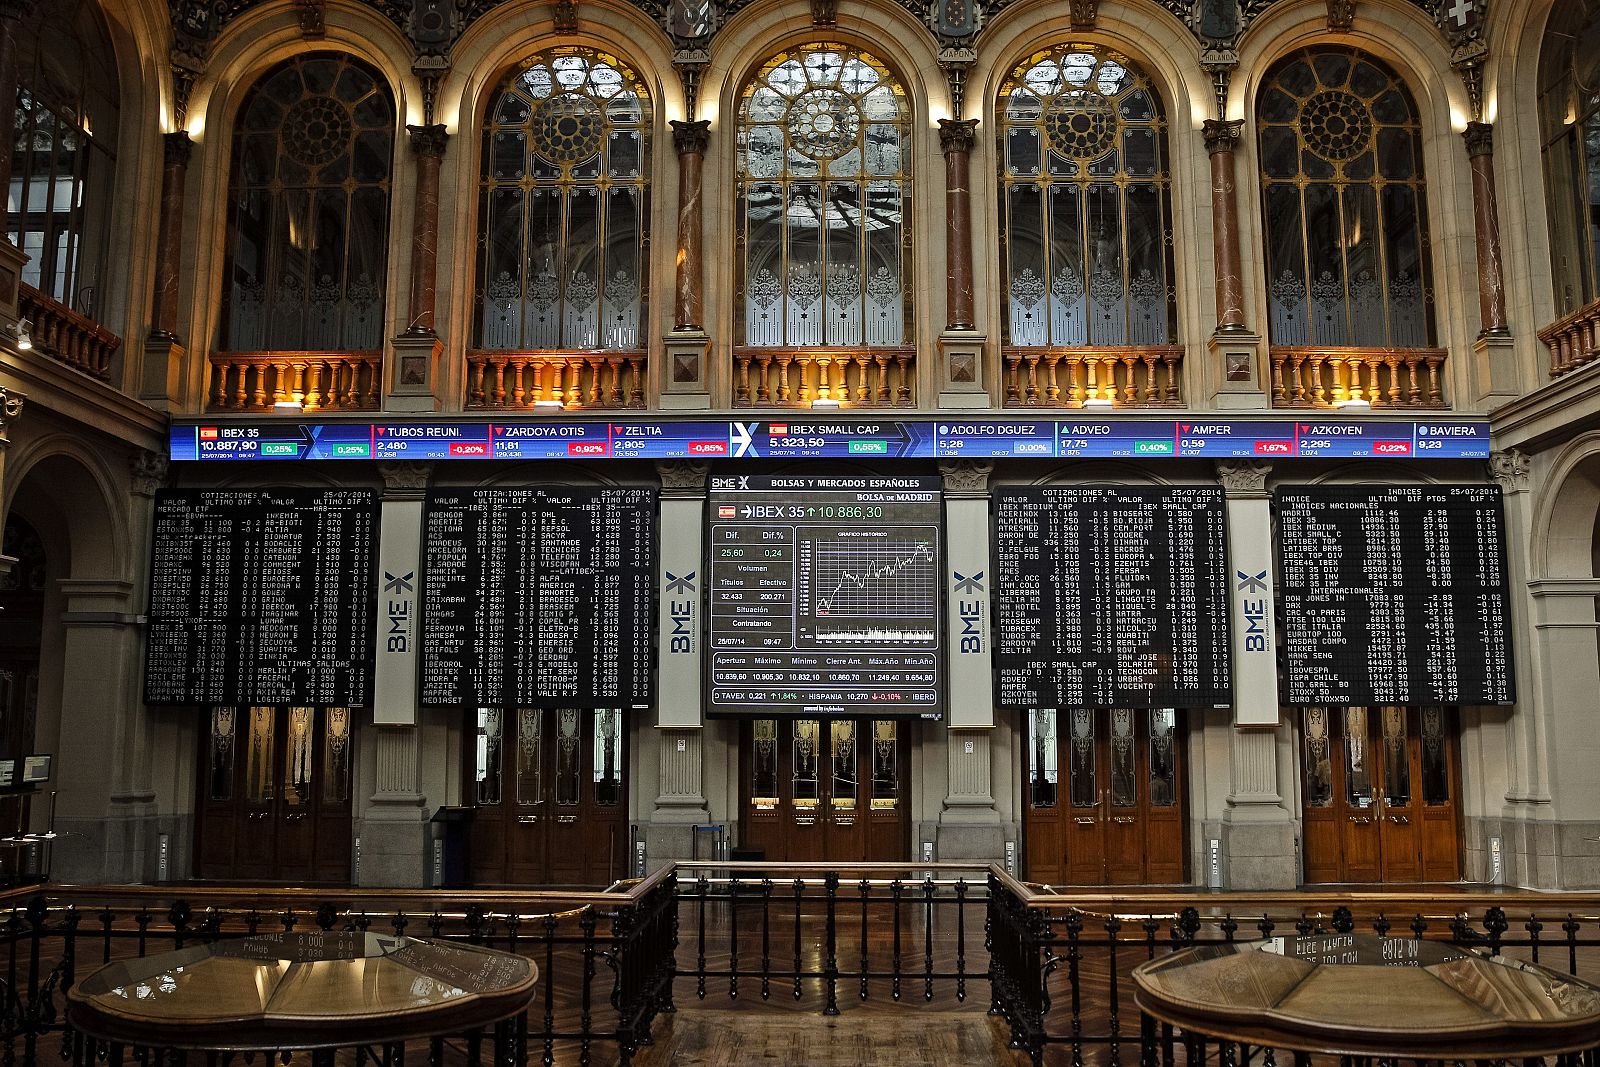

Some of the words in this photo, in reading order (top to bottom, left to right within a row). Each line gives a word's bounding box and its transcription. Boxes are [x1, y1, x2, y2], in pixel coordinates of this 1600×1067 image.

[679, 52, 705, 60] SUECIA
[944, 50, 971, 58] JAPON
[1205, 53, 1234, 61] HOLANDA
[1457, 46, 1480, 59] SUIZA
[221, 429, 245, 438] IBEX
[247, 429, 259, 438] 35
[388, 428, 424, 437] TUBOS
[426, 428, 462, 437] REUNI.
[506, 428, 557, 437] ZARDOYA
[560, 428, 585, 436] OTIS
[625, 427, 662, 436] ZELTIA
[790, 425, 816, 434] IBEX
[818, 425, 855, 434] SMALL
[857, 425, 880, 434] CAP
[950, 426, 995, 435] ADOLFO
[997, 426, 1036, 435] DGUEZ
[1071, 426, 1110, 435] ADVEO
[1192, 425, 1231, 434] AMPER
[1311, 426, 1363, 435] AZKOYEN
[1430, 426, 1476, 436] BAVIERA
[200, 441, 258, 451] 10.887,90
[377, 442, 407, 451] 2,480
[495, 441, 519, 450] 11,81
[614, 441, 645, 449] 2,905
[769, 438, 825, 448] 5.323,50
[853, 443, 882, 451] 0,55%
[939, 440, 964, 449] 5,28
[1061, 440, 1088, 449] 17,75
[1181, 440, 1206, 449] 0,59
[1300, 440, 1331, 449] 2,295
[1418, 440, 1442, 450] 9,23
[266, 445, 293, 453] 0,25%
[337, 445, 364, 454] 0,25%
[571, 445, 603, 453] -0,92%
[692, 444, 724, 452] -0,85%
[1019, 444, 1047, 452] 0,00%
[1140, 444, 1168, 452] 0,40%
[1258, 444, 1288, 452] -1,67%
[1376, 444, 1407, 452] -0,22%
[771, 479, 805, 487] BOLSAS
[808, 479, 814, 487] Y
[817, 479, 866, 487] MERCADOS
[869, 477, 920, 487] ESPAÑOLES
[752, 506, 785, 518] IBEX
[789, 506, 805, 518] 35
[818, 506, 882, 519] 10.886,30
[725, 531, 740, 539] Dif.
[762, 531, 784, 540] Dif.%
[721, 549, 744, 558] 25,60
[764, 549, 782, 557] 0,24
[759, 578, 787, 586] Efectivo
[388, 600, 407, 653] BME
[671, 600, 690, 653] BME
[960, 600, 980, 653] BME
[1244, 599, 1264, 652] BME
[716, 657, 746, 665] Apertura
[754, 656, 781, 664] Máximo
[826, 657, 846, 665] Cierre
[848, 657, 862, 665] Ant.
